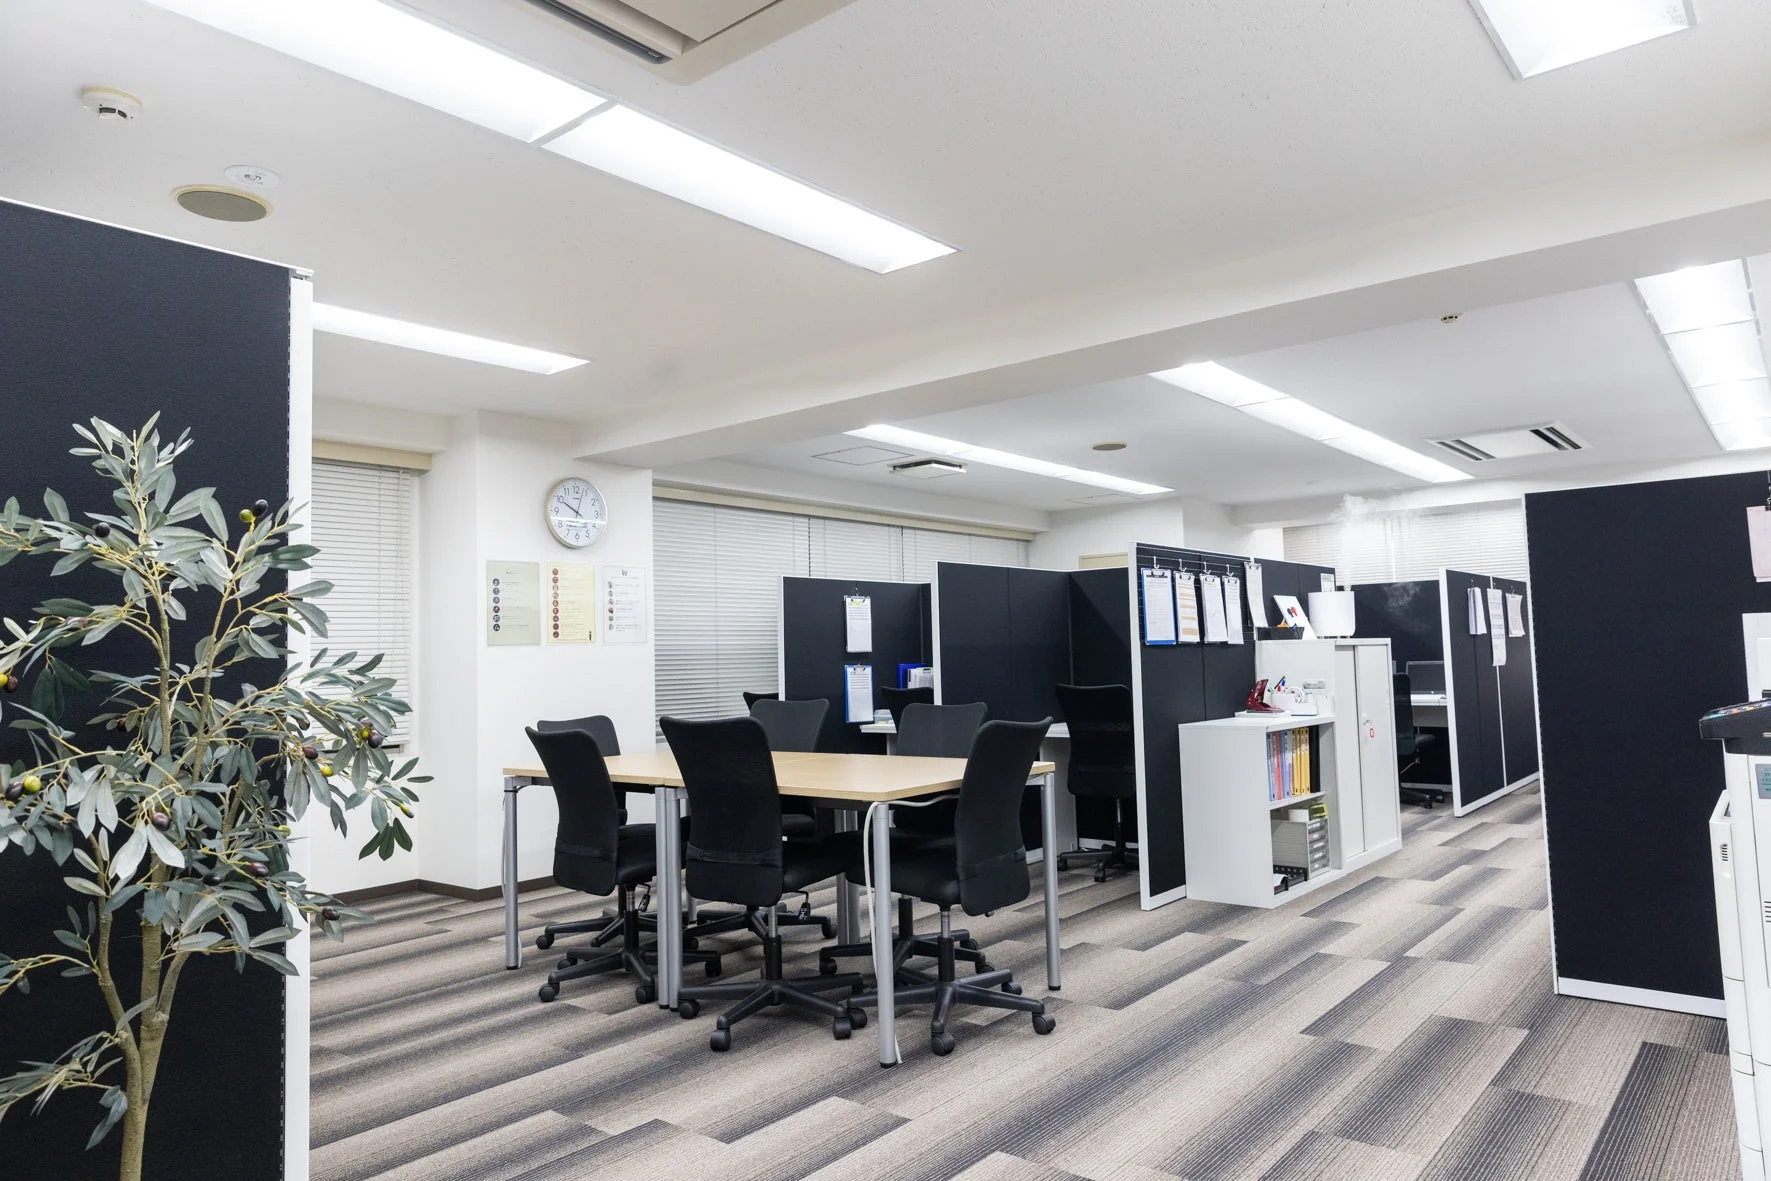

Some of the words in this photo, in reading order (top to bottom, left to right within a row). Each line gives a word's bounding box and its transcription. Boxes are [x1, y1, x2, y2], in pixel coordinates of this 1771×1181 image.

[563, 487, 570, 496] 11
[572, 485, 580, 494] 12
[554, 506, 560, 515] 9
[594, 510, 599, 519] 3
[574, 531, 580, 540] 6
